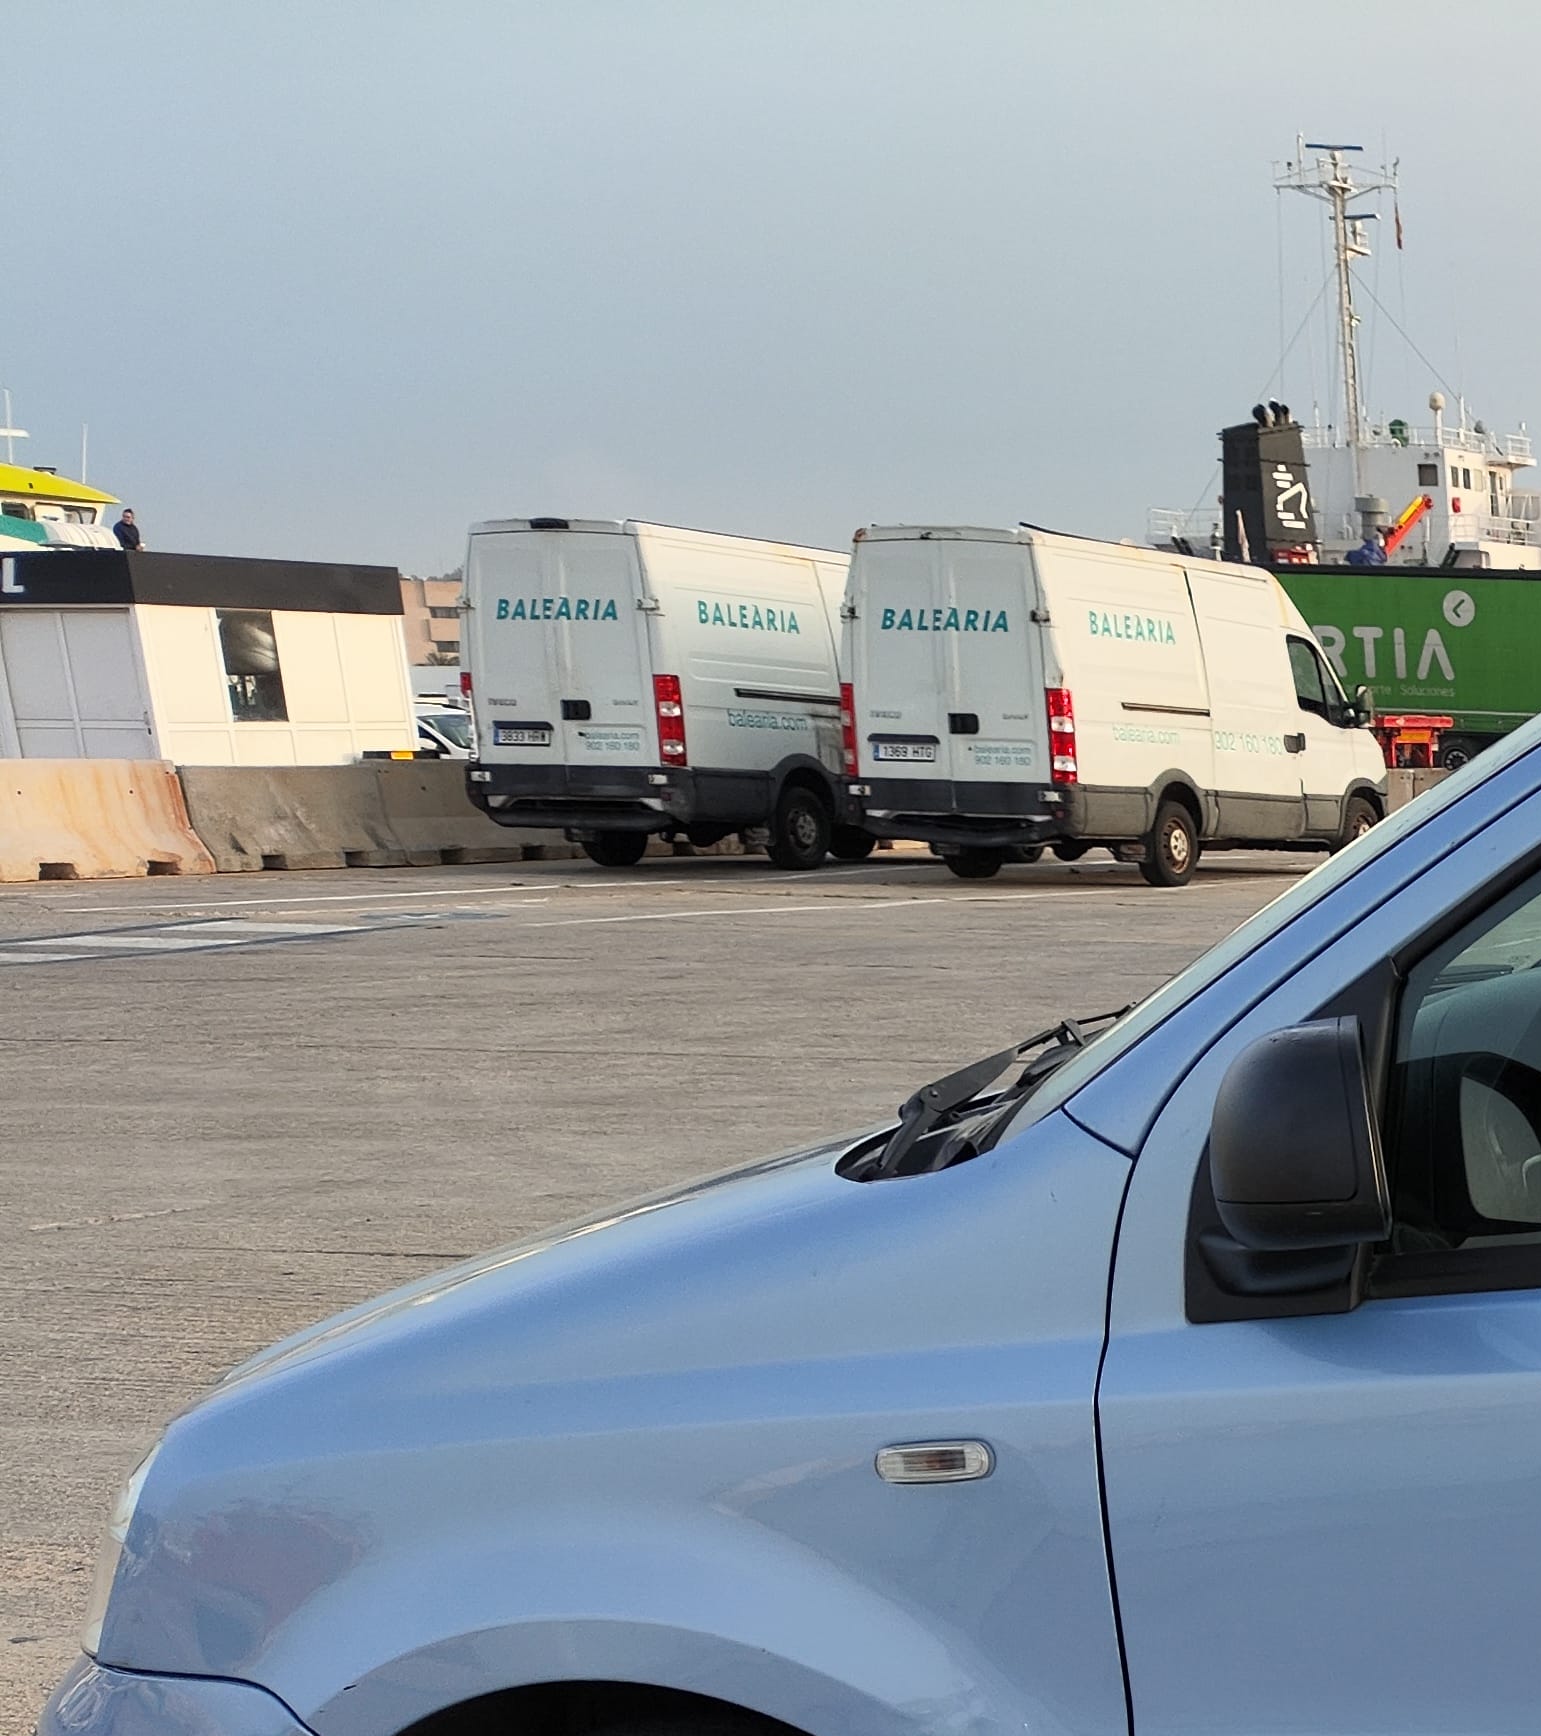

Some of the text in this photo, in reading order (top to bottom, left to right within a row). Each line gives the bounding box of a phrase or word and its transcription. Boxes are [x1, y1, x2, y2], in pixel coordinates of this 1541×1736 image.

[496, 596, 619, 621] BALEÀRIA
[697, 600, 801, 635] BALEÀRIA
[881, 606, 1009, 633] BALEÀRIA
[1088, 610, 1177, 646] BALEÀRIA
[726, 707, 809, 731] balearia.com
[883, 745, 909, 758] 1369
[1240, 733, 1260, 754] 160
